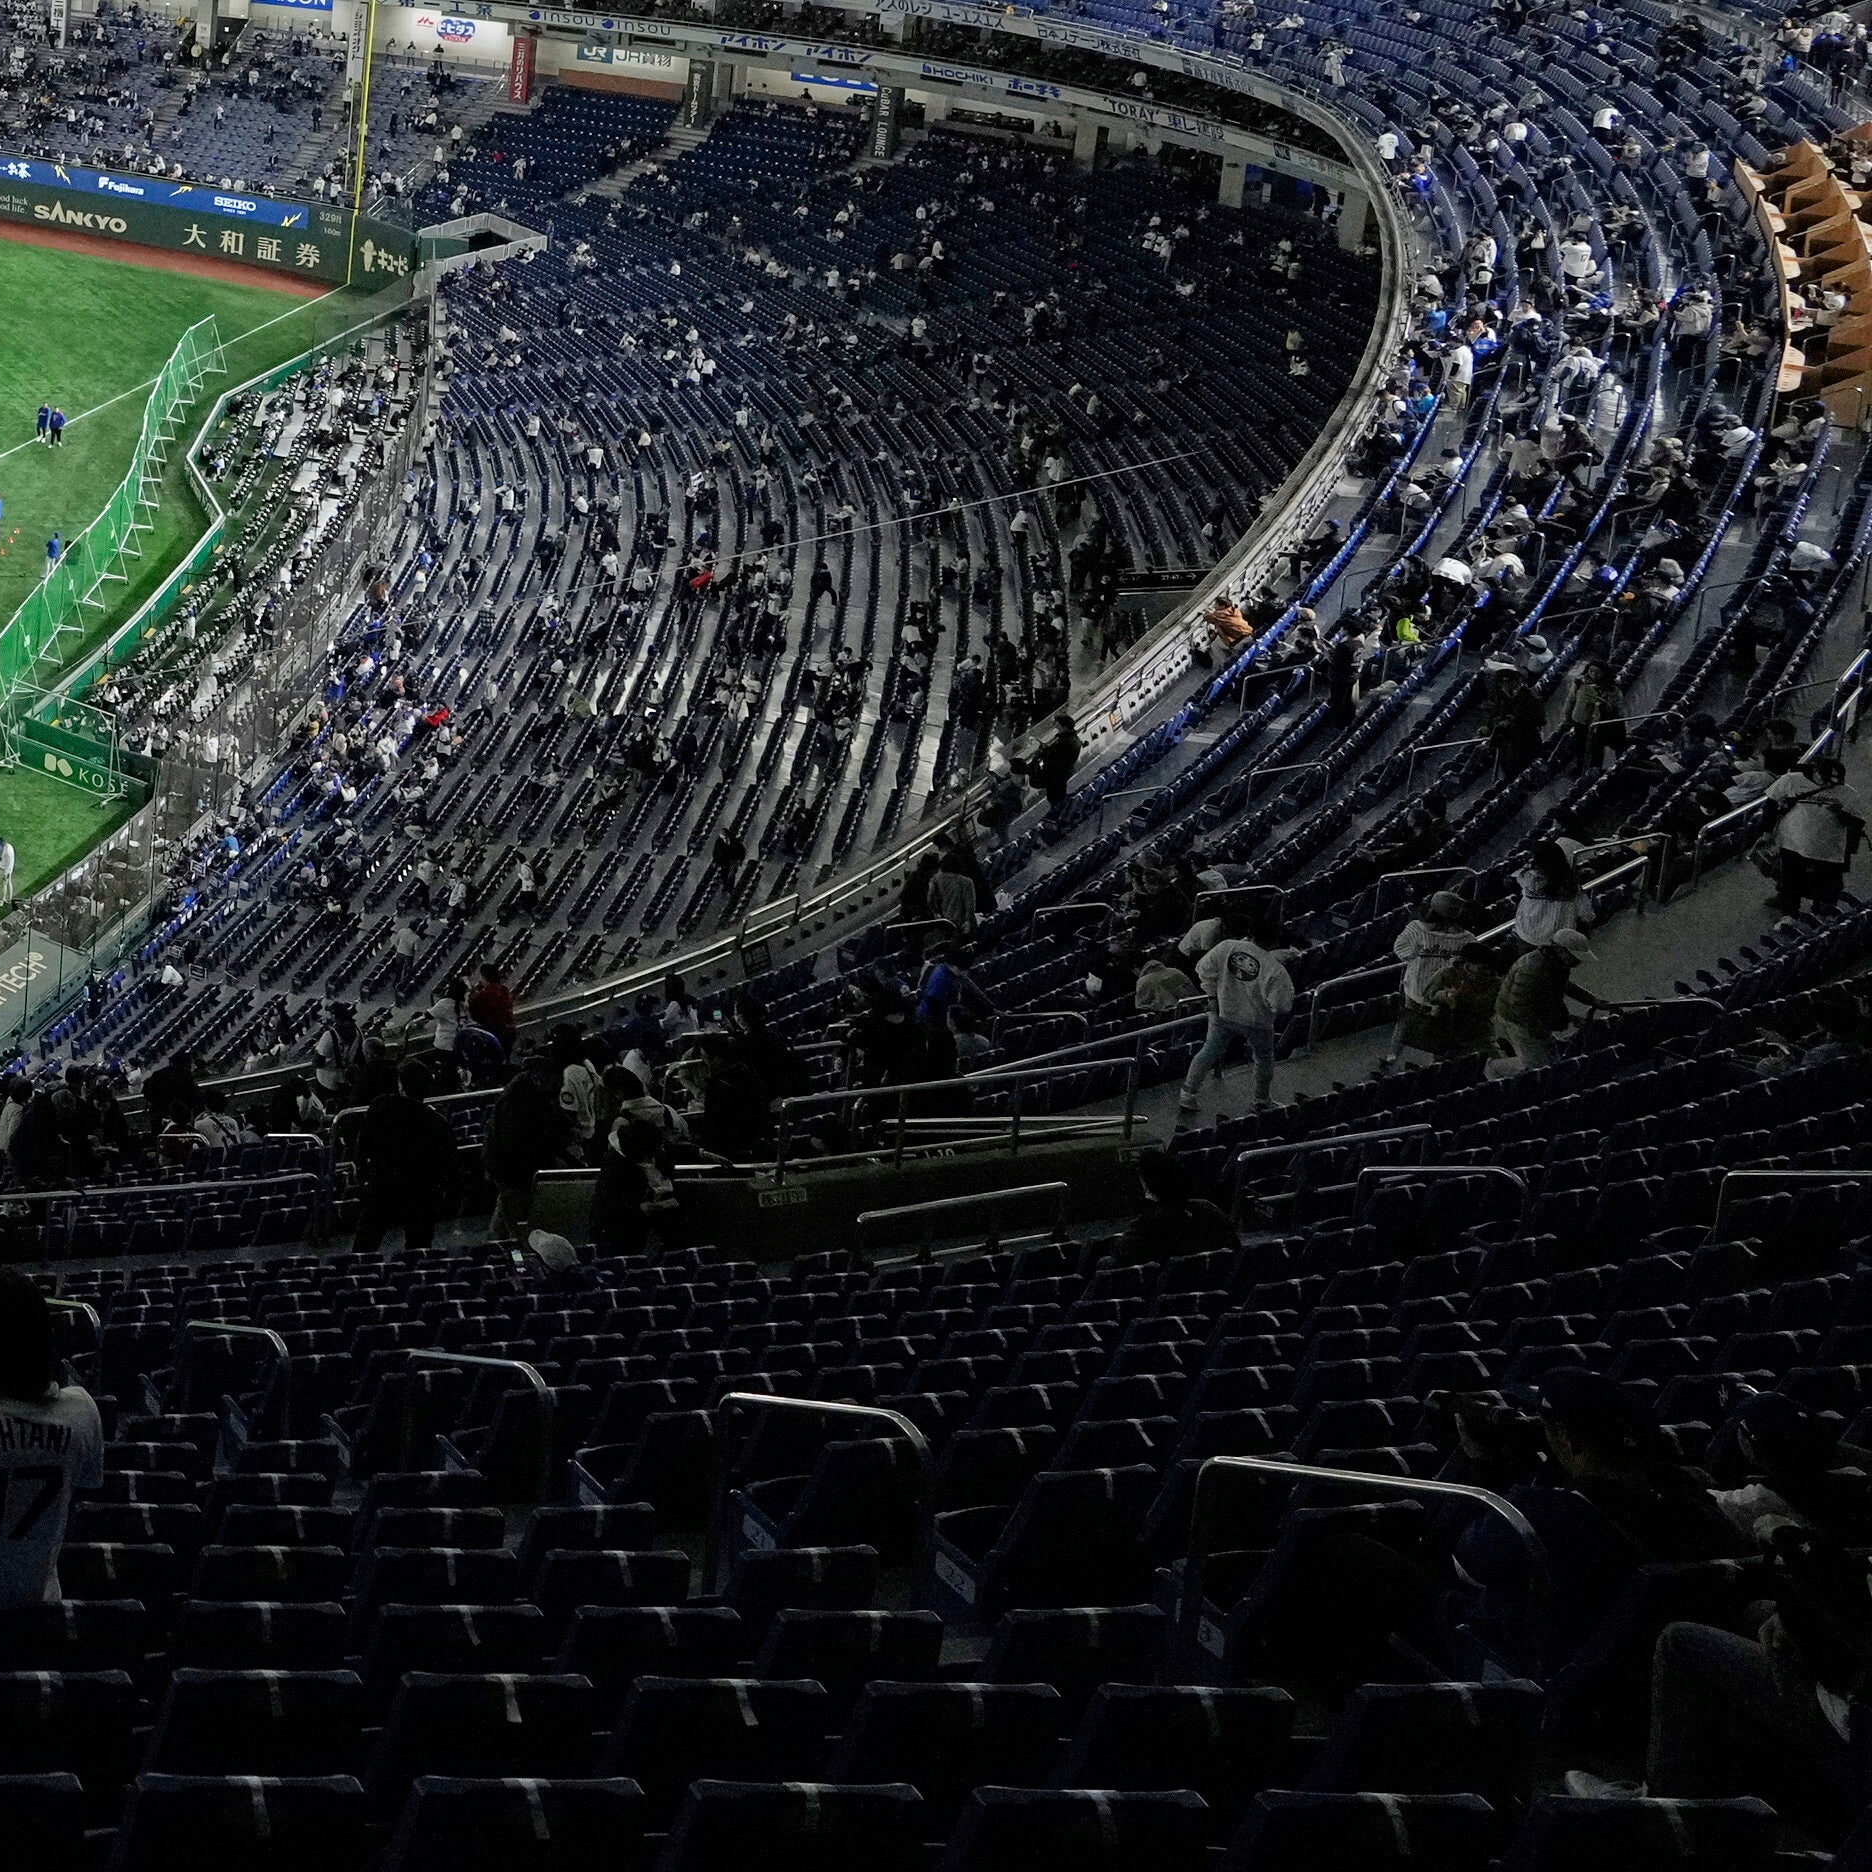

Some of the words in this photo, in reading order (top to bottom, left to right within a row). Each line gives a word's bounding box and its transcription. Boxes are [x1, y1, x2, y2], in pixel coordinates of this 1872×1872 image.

[9, 195, 29, 206] luck.
[214, 196, 257, 213] SEIKO
[34, 201, 128, 234] SANKYO
[319, 212, 343, 225] 329ft
[184, 223, 321, 270] 大和証券
